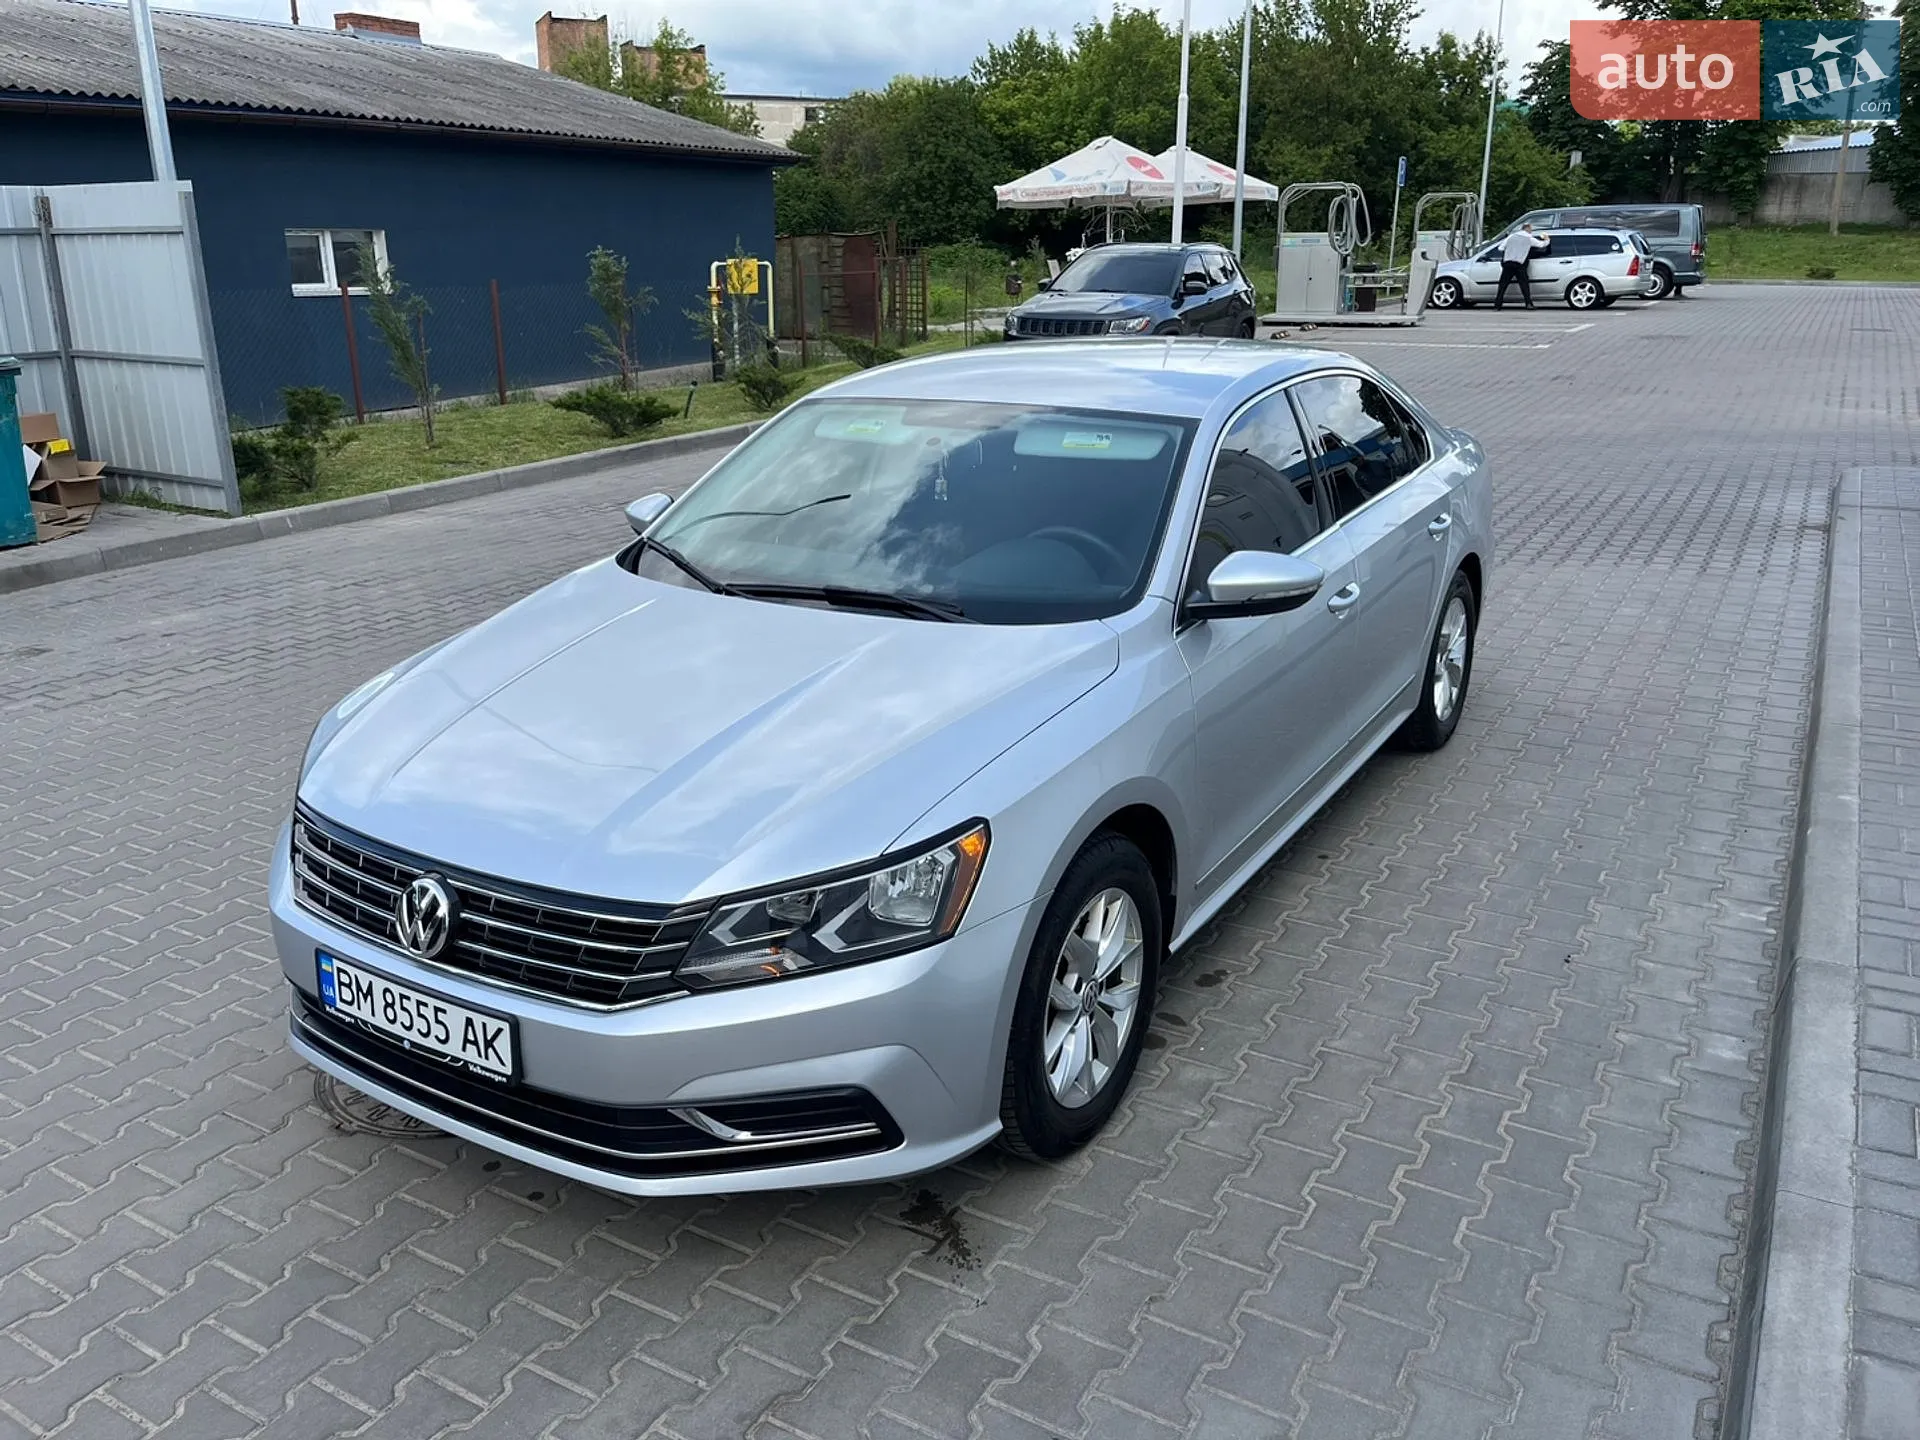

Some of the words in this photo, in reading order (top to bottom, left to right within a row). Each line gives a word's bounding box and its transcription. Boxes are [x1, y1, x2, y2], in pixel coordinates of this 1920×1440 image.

[322, 983, 335, 998] UA
[337, 966, 375, 1018] BM
[382, 987, 450, 1045] 8555
[461, 1016, 507, 1068] AK
